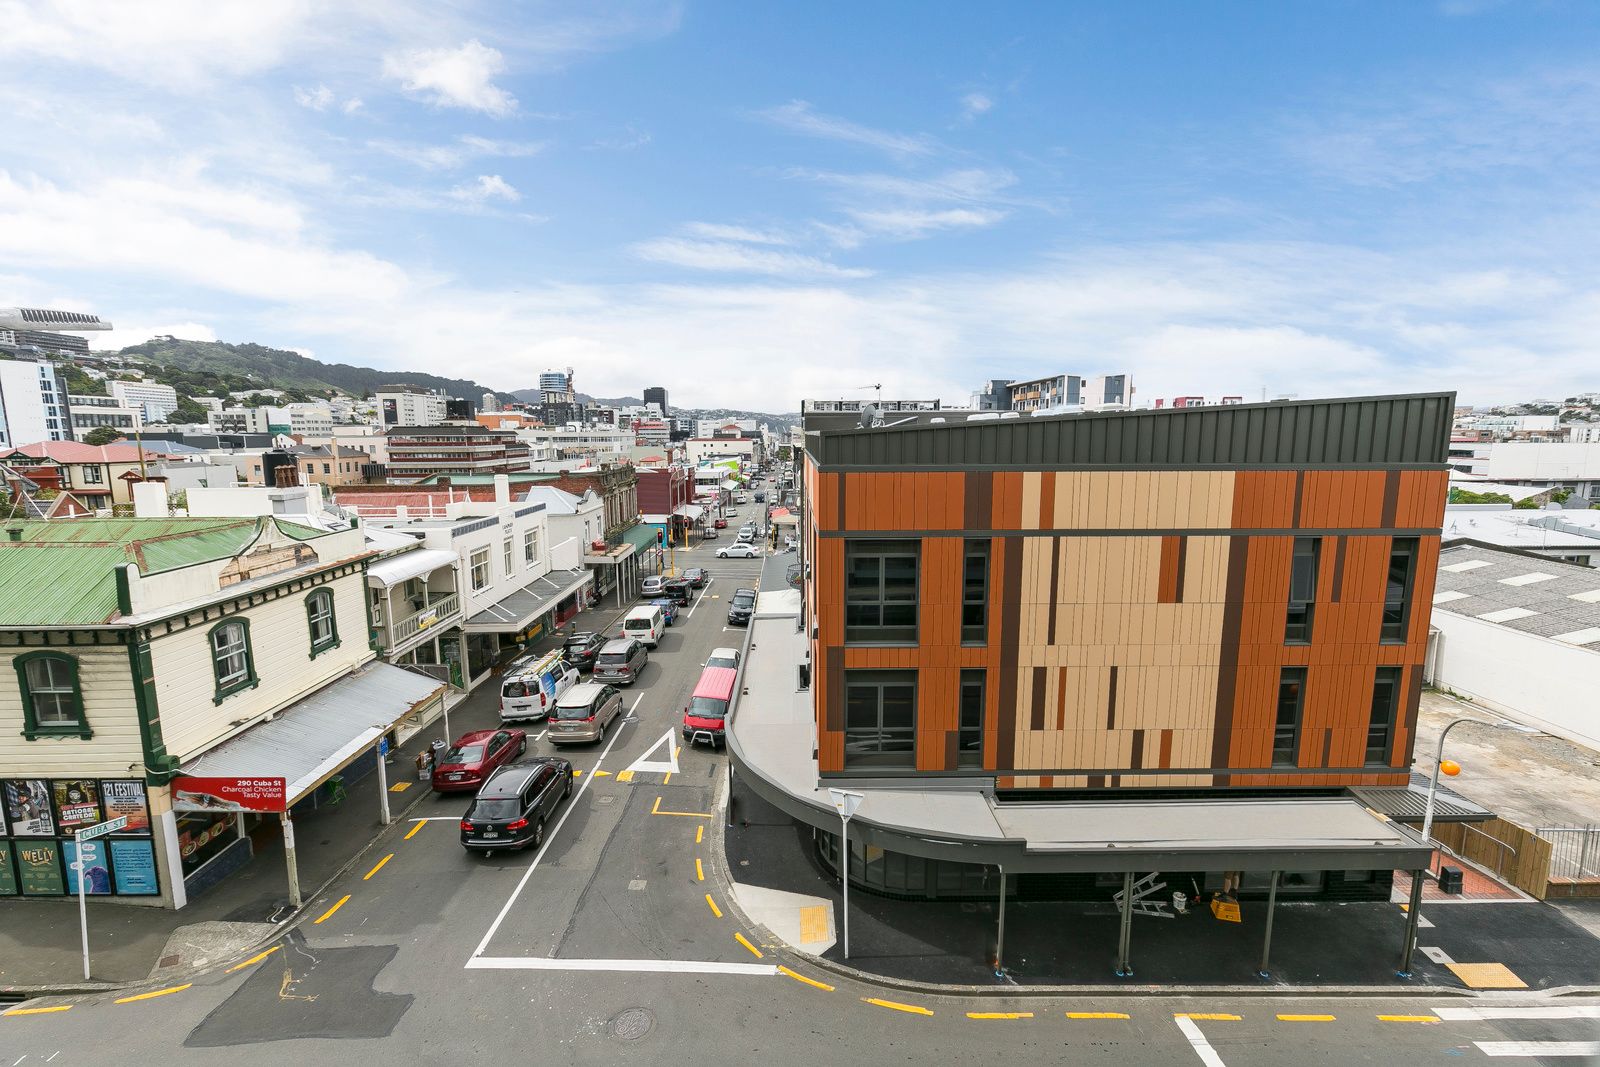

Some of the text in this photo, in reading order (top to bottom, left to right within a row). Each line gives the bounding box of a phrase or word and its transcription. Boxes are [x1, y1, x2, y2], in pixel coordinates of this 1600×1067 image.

[103, 783, 145, 796] 121 FESTIVAL
[82, 819, 125, 839] CUBA ST
[21, 849, 53, 862] WELLY
